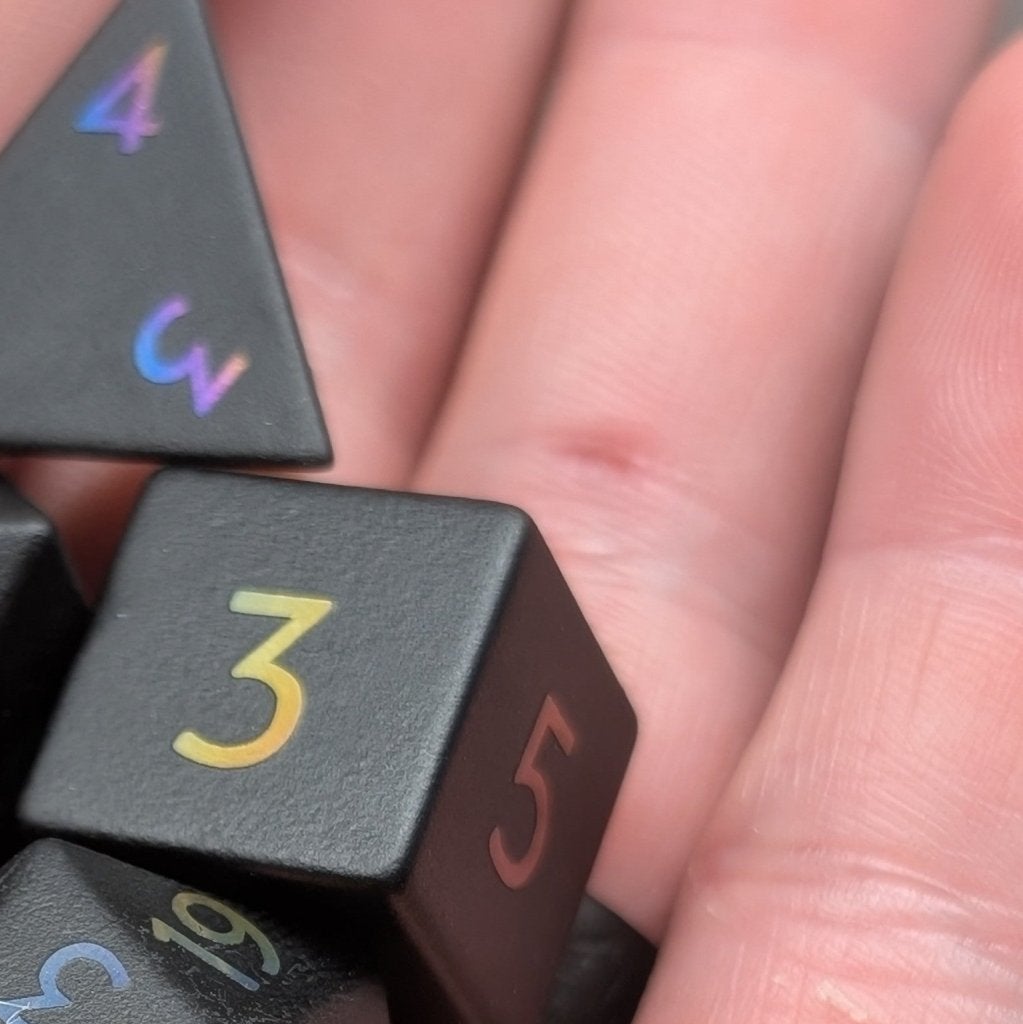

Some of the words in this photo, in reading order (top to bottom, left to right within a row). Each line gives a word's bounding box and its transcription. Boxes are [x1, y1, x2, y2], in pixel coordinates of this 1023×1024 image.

[73, 41, 167, 154] 4
[134, 294, 248, 417] 3
[172, 589, 334, 769] 3
[489, 694, 575, 890] 5
[151, 892, 280, 992] 19
